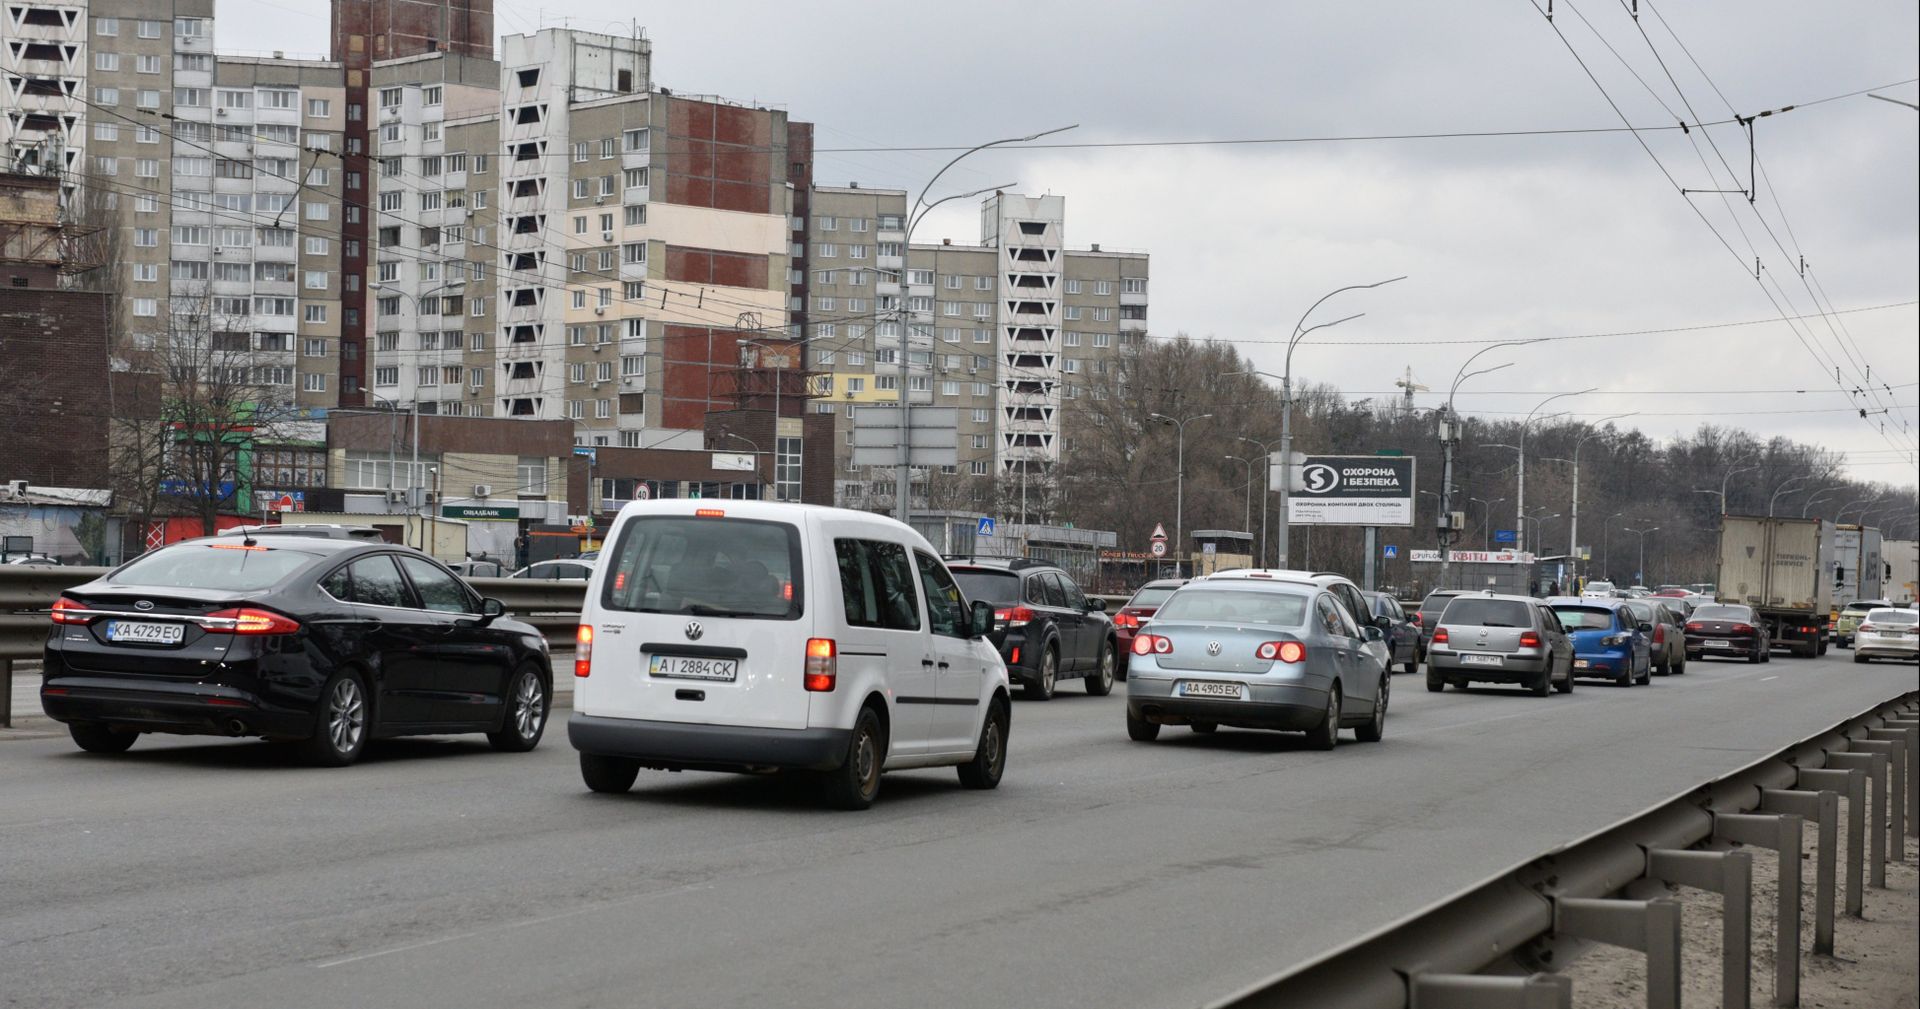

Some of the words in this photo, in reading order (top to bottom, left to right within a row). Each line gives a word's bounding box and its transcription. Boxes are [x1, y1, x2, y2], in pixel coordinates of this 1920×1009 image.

[1342, 468, 1395, 476] ОХОРОНА
[1343, 478, 1347, 486] І
[1349, 478, 1399, 486] БЕЗПЕКА
[637, 490, 646, 500] 40
[114, 624, 131, 636] KA
[133, 625, 161, 638] 4729
[163, 627, 181, 639] EO
[659, 659, 676, 672] AI
[680, 660, 710, 674] 2884
[713, 662, 733, 676] CK
[1186, 682, 1199, 693] AA
[1201, 684, 1223, 695] 4905
[1225, 685, 1239, 696] EK
